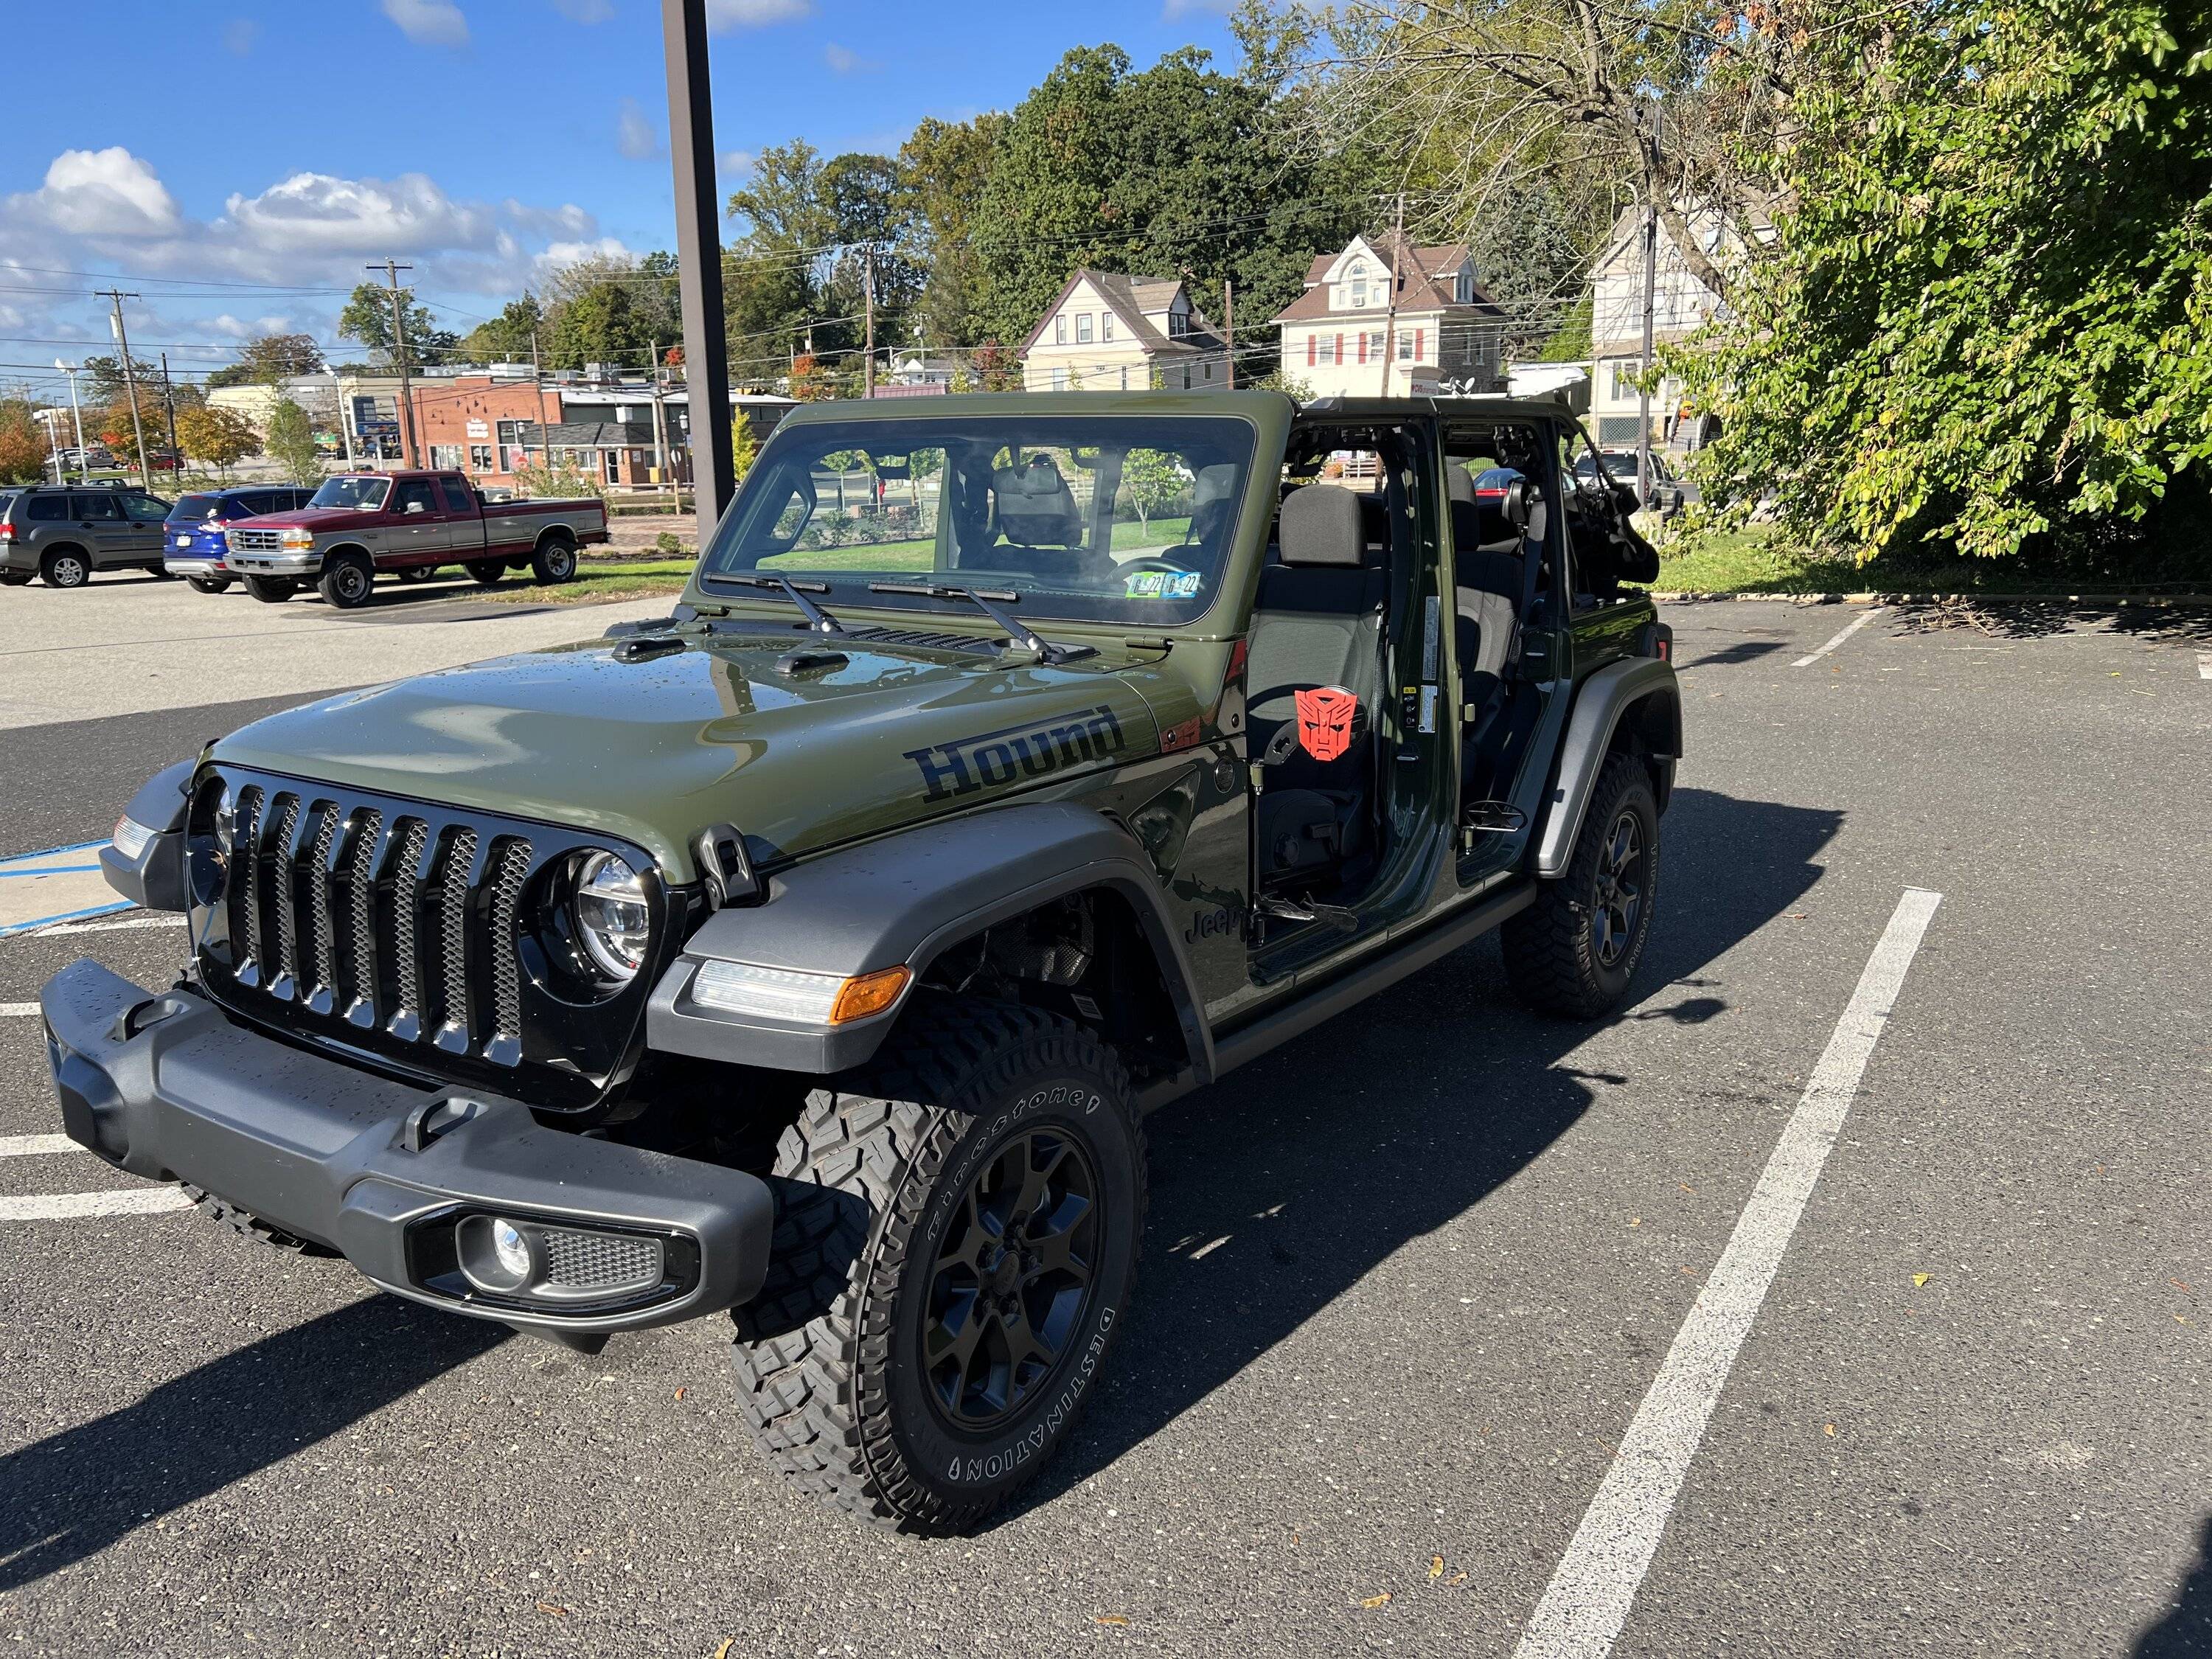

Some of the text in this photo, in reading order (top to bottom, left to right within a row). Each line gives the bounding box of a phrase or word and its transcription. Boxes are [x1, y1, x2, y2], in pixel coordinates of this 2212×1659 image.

[1147, 577, 1161, 593] 22
[1183, 576, 1196, 592] 22
[902, 704, 1126, 804] Hound
[1184, 909, 1240, 945] Jeep
[928, 1087, 1084, 1242] Firestone
[966, 1307, 1116, 1482] DESTINATION
